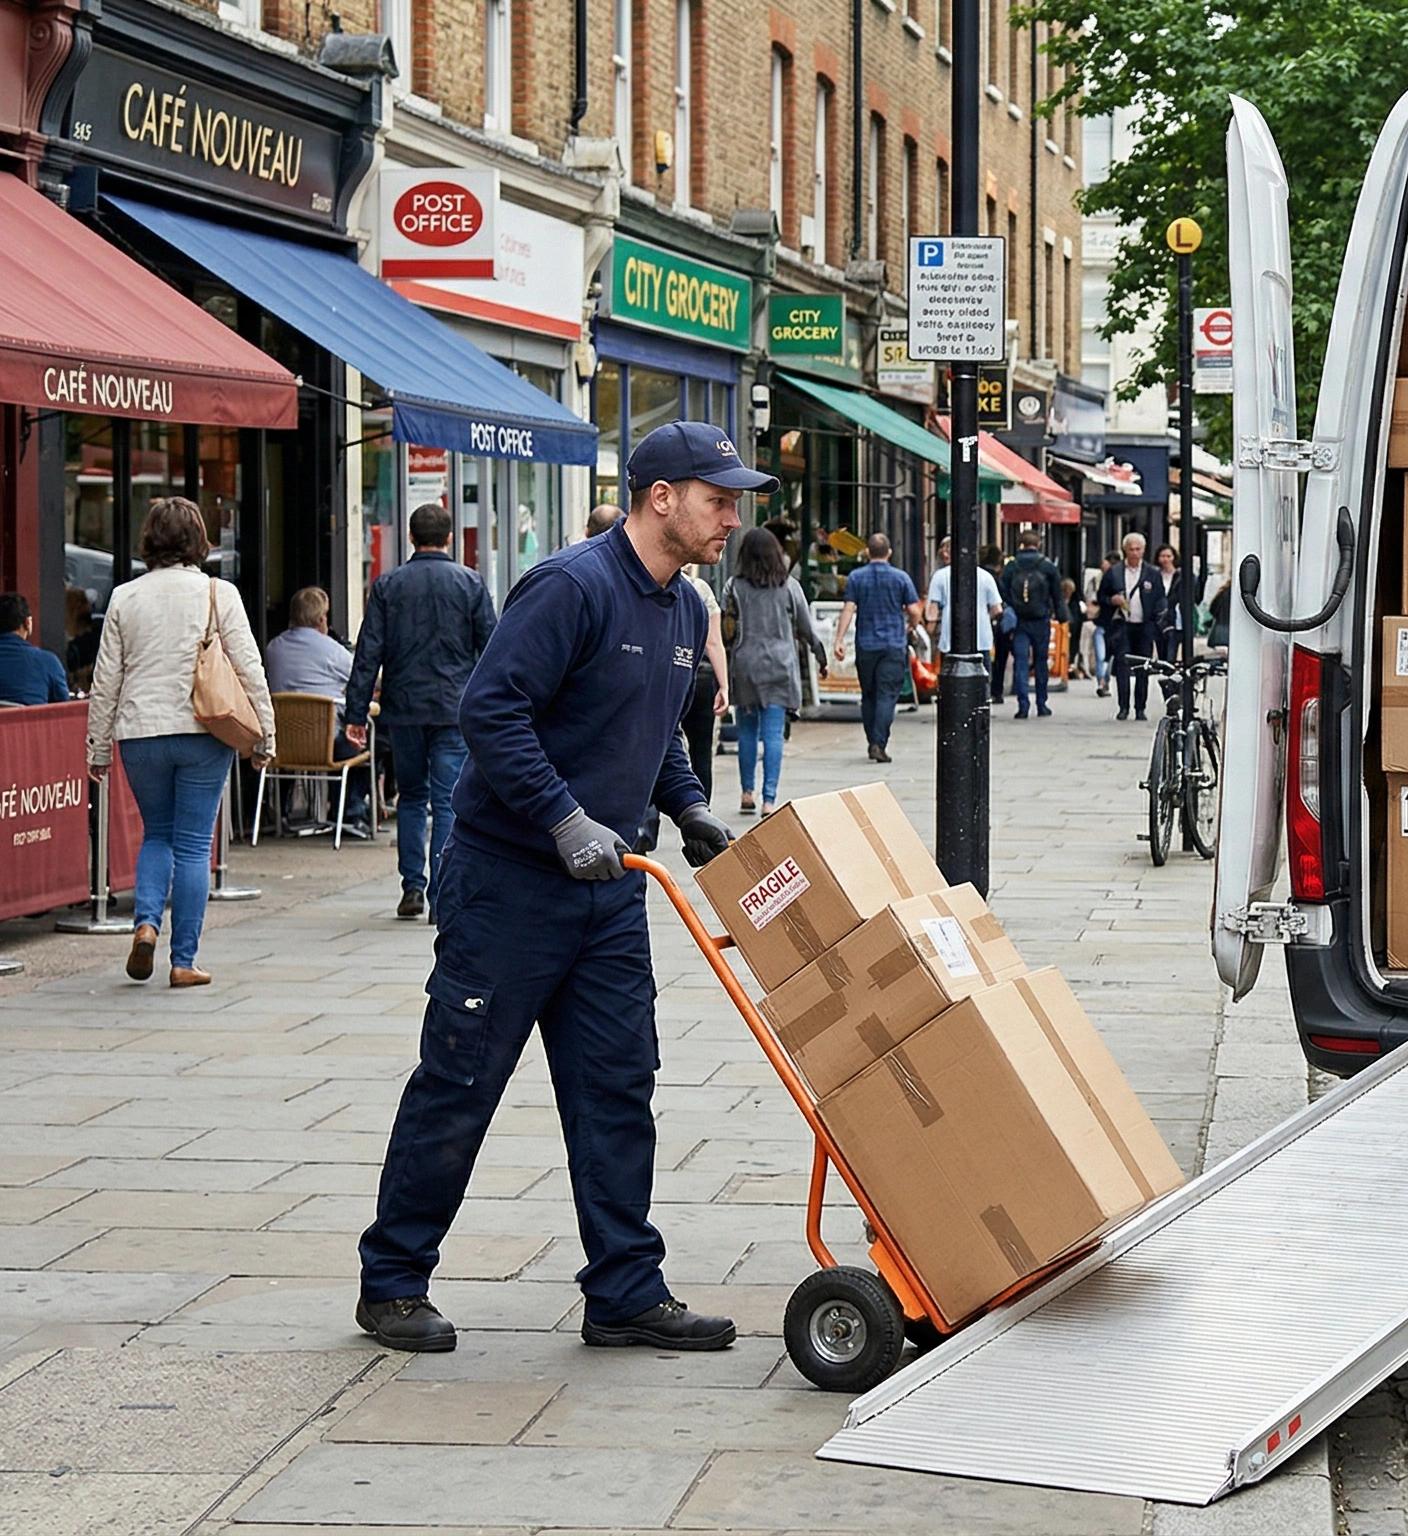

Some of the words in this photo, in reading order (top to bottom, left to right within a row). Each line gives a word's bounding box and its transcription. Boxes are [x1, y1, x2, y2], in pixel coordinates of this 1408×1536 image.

[124, 83, 185, 153] CAFÉ
[192, 103, 303, 187] NOUVEAU
[413, 194, 465, 212] POST
[401, 214, 473, 233] OFFICE
[1176, 223, 1193, 248] L
[924, 244, 939, 265] P
[624, 256, 664, 312] CITY
[666, 270, 740, 331] GROCERY
[789, 309, 822, 324] CITY
[772, 326, 839, 340] GROCERY
[44, 362, 87, 405] CAFÉ
[92, 373, 174, 414] NOUVEAU
[978, 397, 1001, 412] KE
[471, 422, 496, 452] POST
[497, 426, 533, 457] OFFICE
[0, 783, 17, 819] FÉ
[741, 860, 800, 915] FRAGILE
